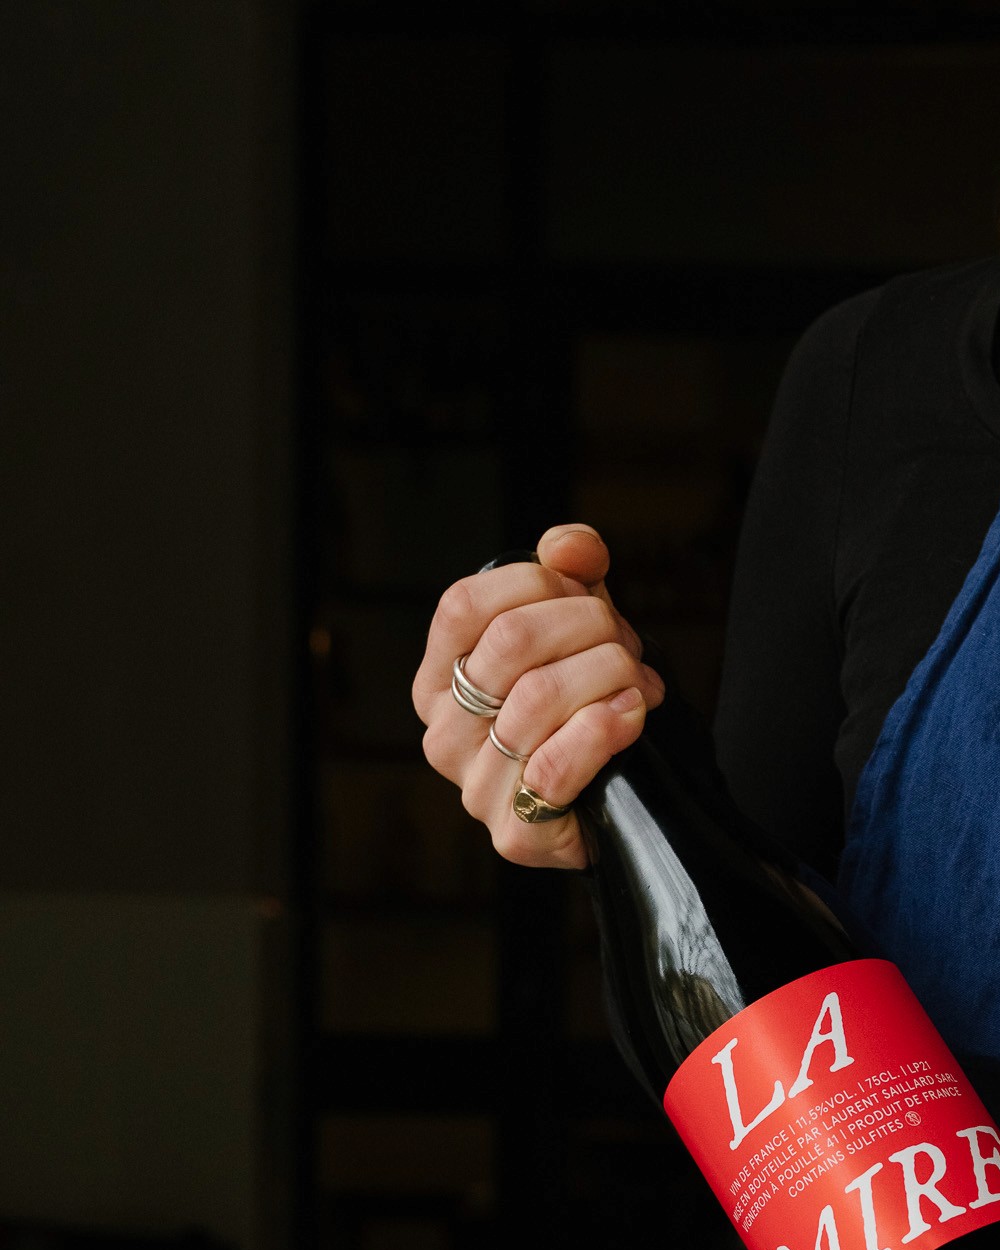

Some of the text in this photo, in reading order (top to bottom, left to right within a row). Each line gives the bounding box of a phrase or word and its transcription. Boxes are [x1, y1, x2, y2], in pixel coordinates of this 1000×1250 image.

[711, 991, 856, 1151] LA
[730, 1180, 741, 1196] VIN
[739, 1167, 751, 1182] DE
[749, 1130, 789, 1170] FRANCE
[865, 1071, 900, 1088] 75CL.
[907, 1061, 931, 1073] LP21
[733, 1073, 958, 1223] MISE EN BOUTEILLE PAR LAURENT SAILLARD SARL
[742, 1192, 771, 1232] VIGNERON
[771, 1183, 779, 1194] À
[778, 1145, 824, 1186] POUILLÉ
[827, 1136, 839, 1147] 41
[848, 1102, 902, 1134] PRODUIT
[904, 1094, 922, 1107] DE
[922, 1087, 962, 1102] FRANCE
[788, 1120, 903, 1197] CONTAINS SULFITES
